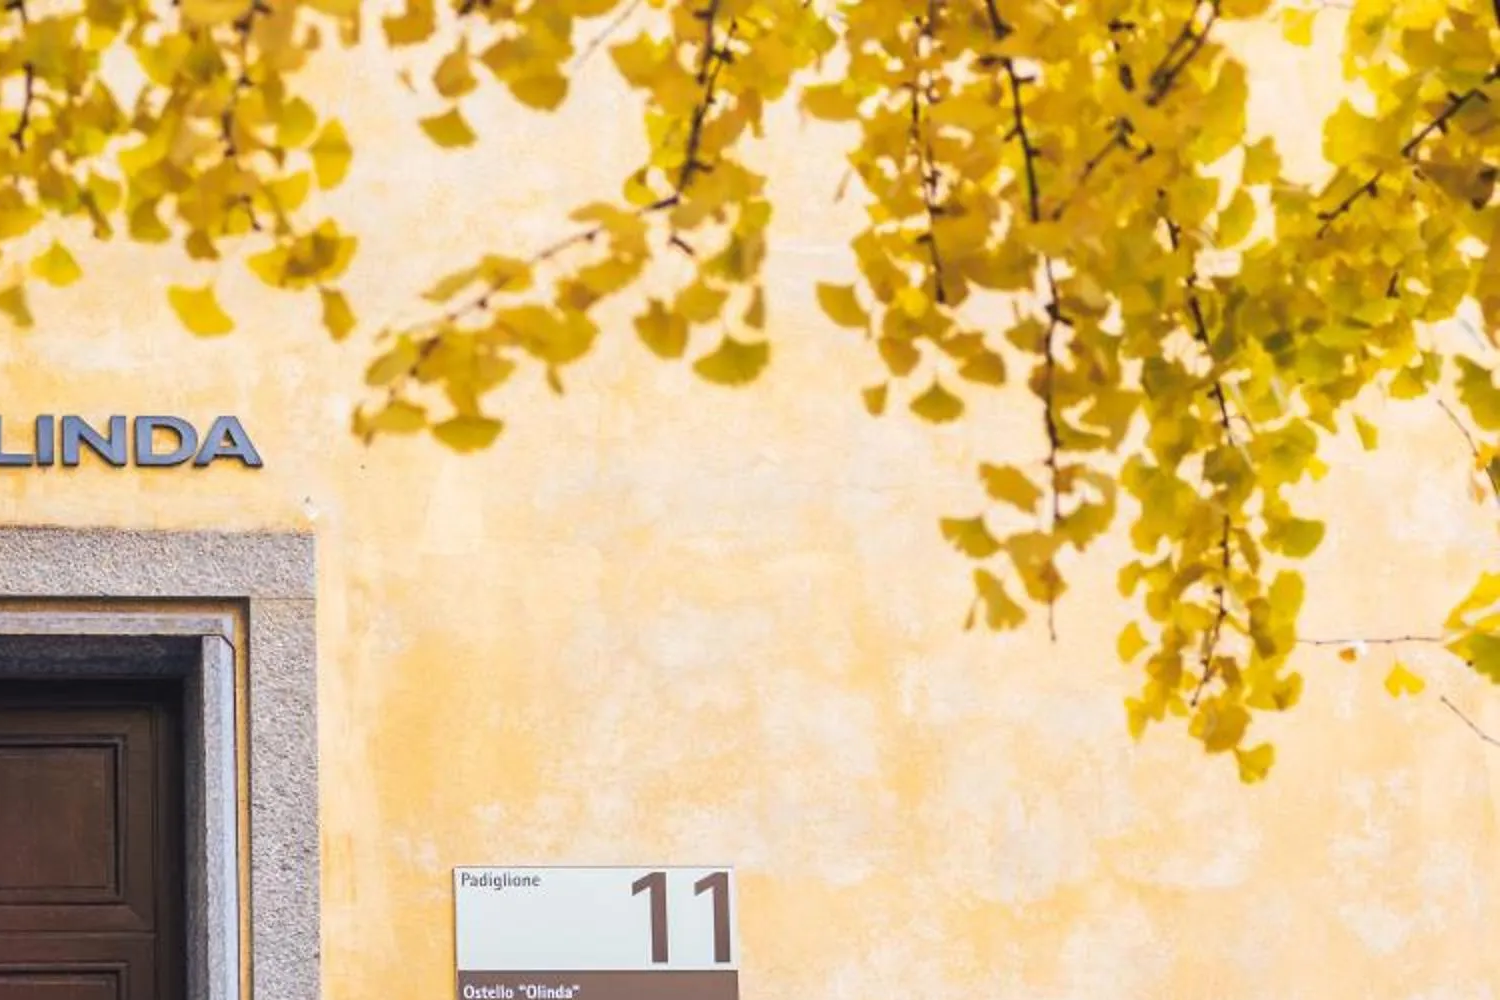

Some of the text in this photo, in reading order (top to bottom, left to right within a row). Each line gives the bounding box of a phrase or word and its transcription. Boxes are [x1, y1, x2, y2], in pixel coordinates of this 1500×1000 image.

[460, 871, 542, 890] Padiglione
[631, 871, 731, 963] 11
[463, 984, 580, 1000] Ostello "Olinda"
